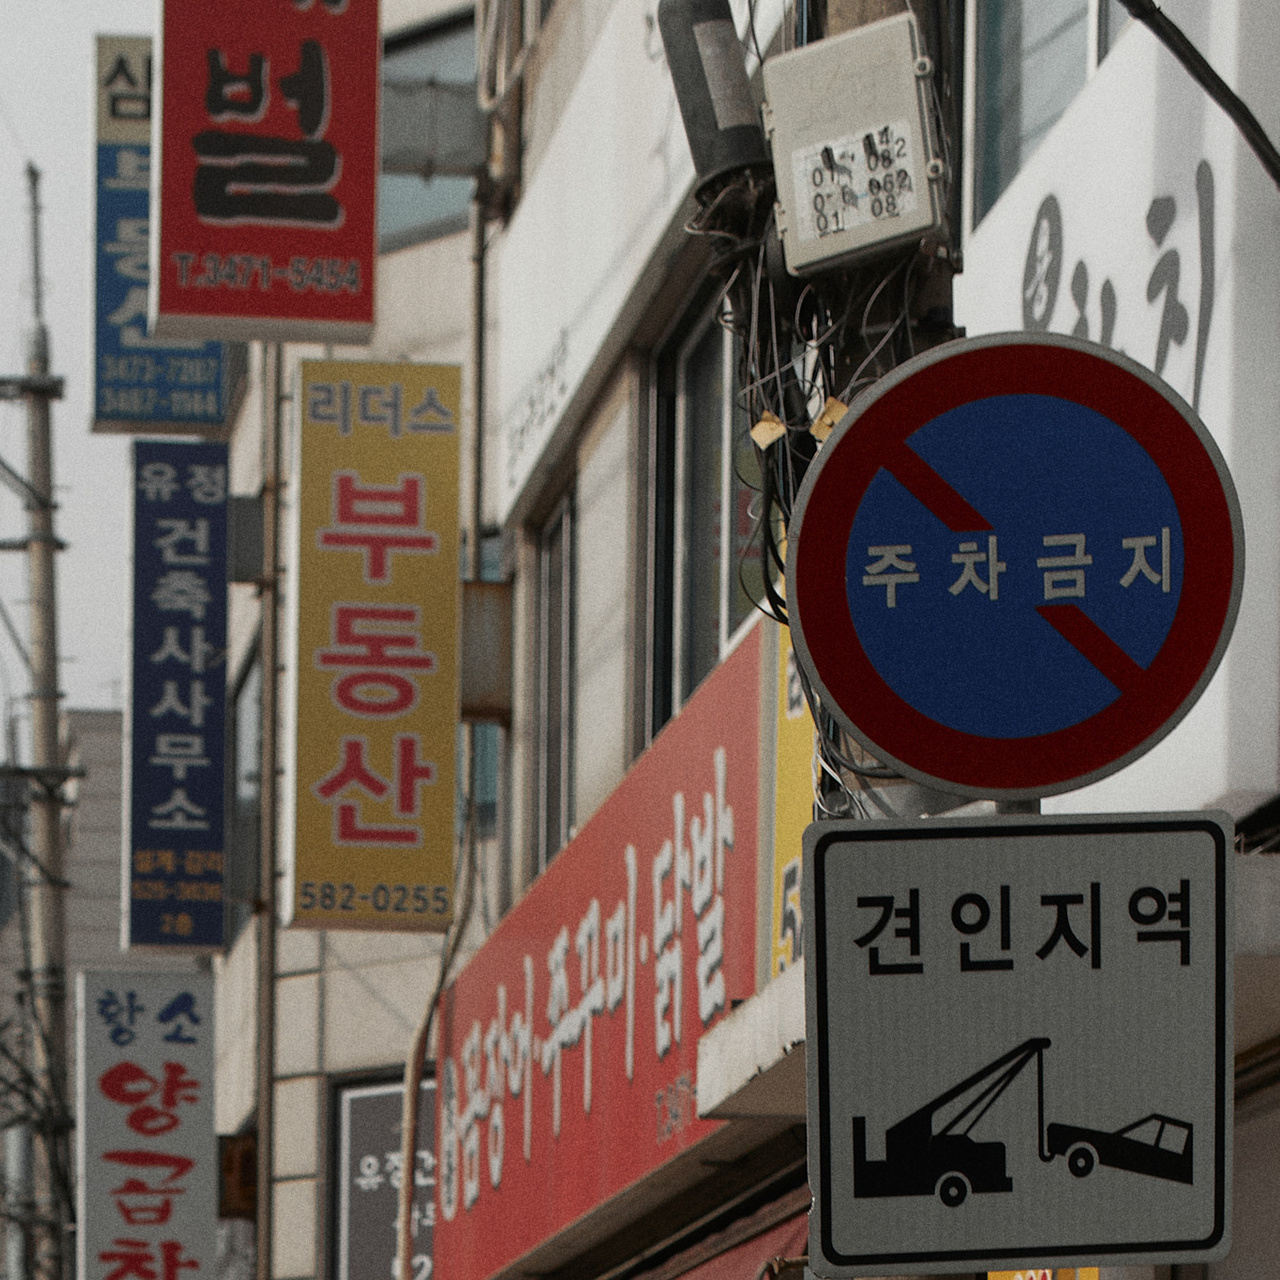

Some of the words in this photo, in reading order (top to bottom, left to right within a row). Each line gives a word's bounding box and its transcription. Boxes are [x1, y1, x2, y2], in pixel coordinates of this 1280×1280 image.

[193, 0, 345, 230] 벌
[307, 380, 458, 438] 리더스
[862, 527, 1172, 608] 주차금지
[148, 517, 217, 831] 건축사사무소
[317, 470, 437, 846] 부동산
[299, 881, 451, 914] 582-0255
[853, 879, 1191, 976] 견인지역
